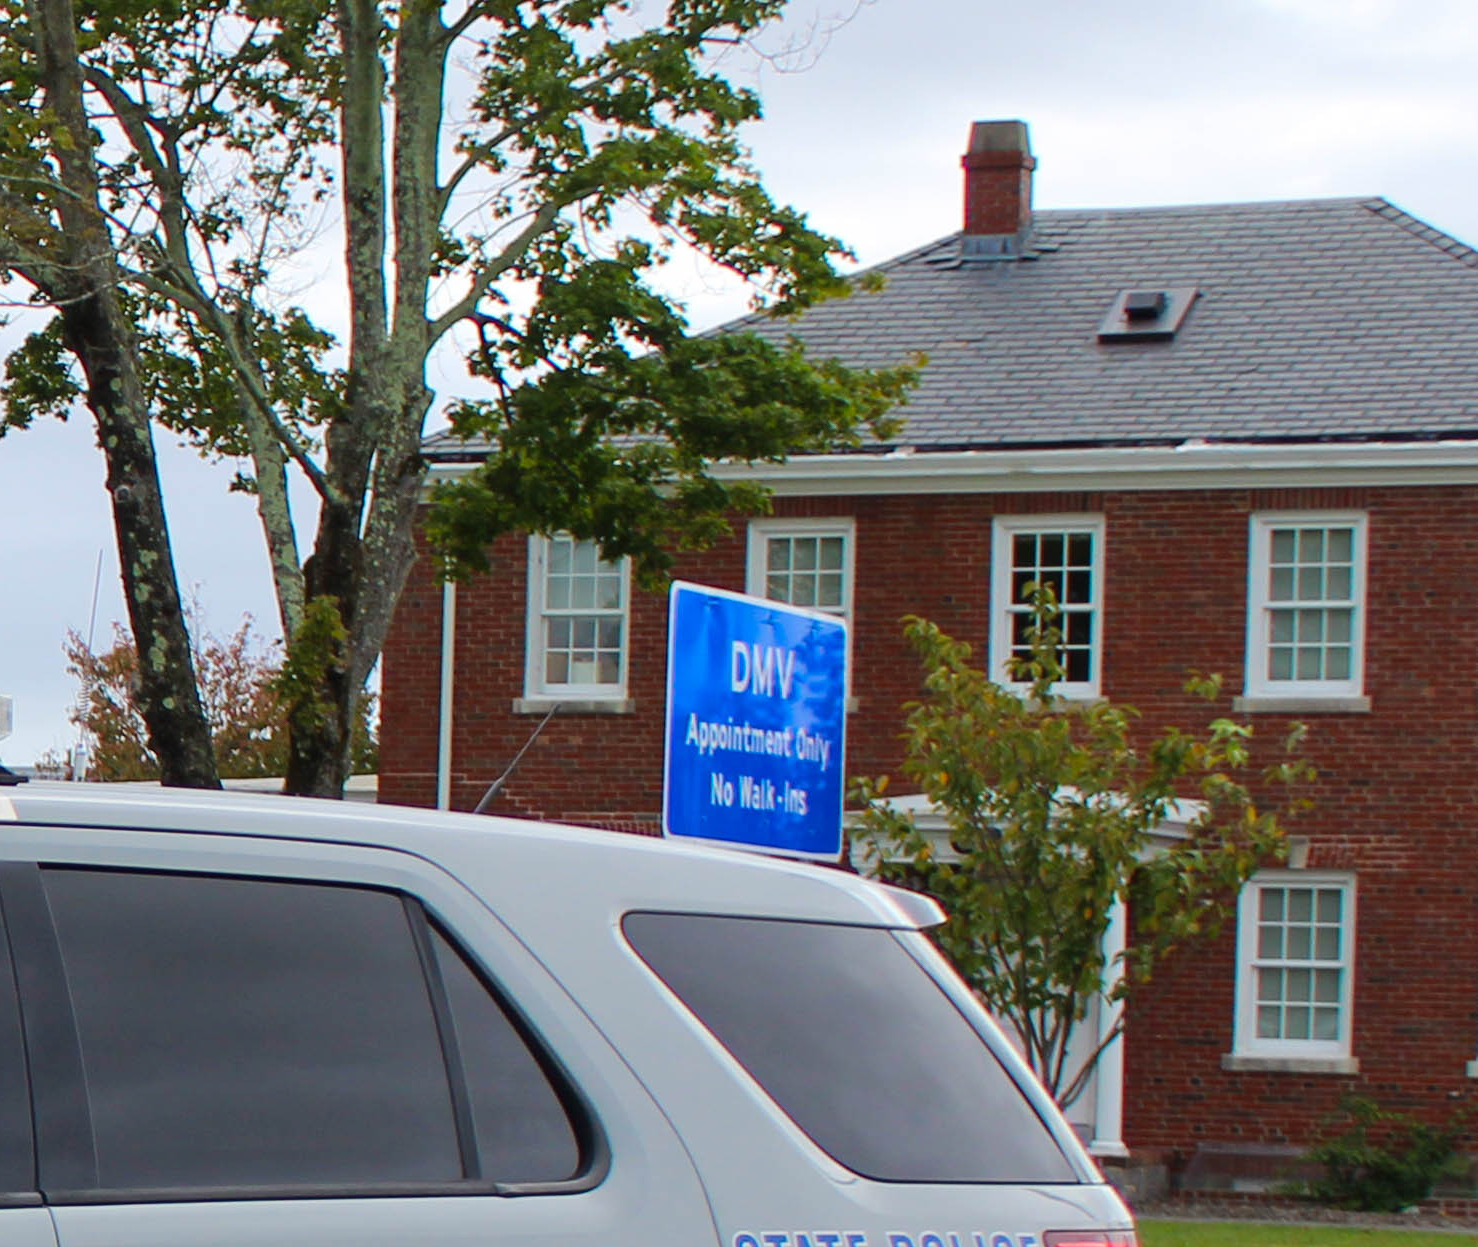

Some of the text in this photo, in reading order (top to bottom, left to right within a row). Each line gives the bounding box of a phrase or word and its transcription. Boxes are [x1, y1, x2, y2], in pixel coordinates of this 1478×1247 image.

[731, 640, 796, 699] DMV
[685, 712, 832, 772] Appointment Only
[710, 772, 735, 807] No
